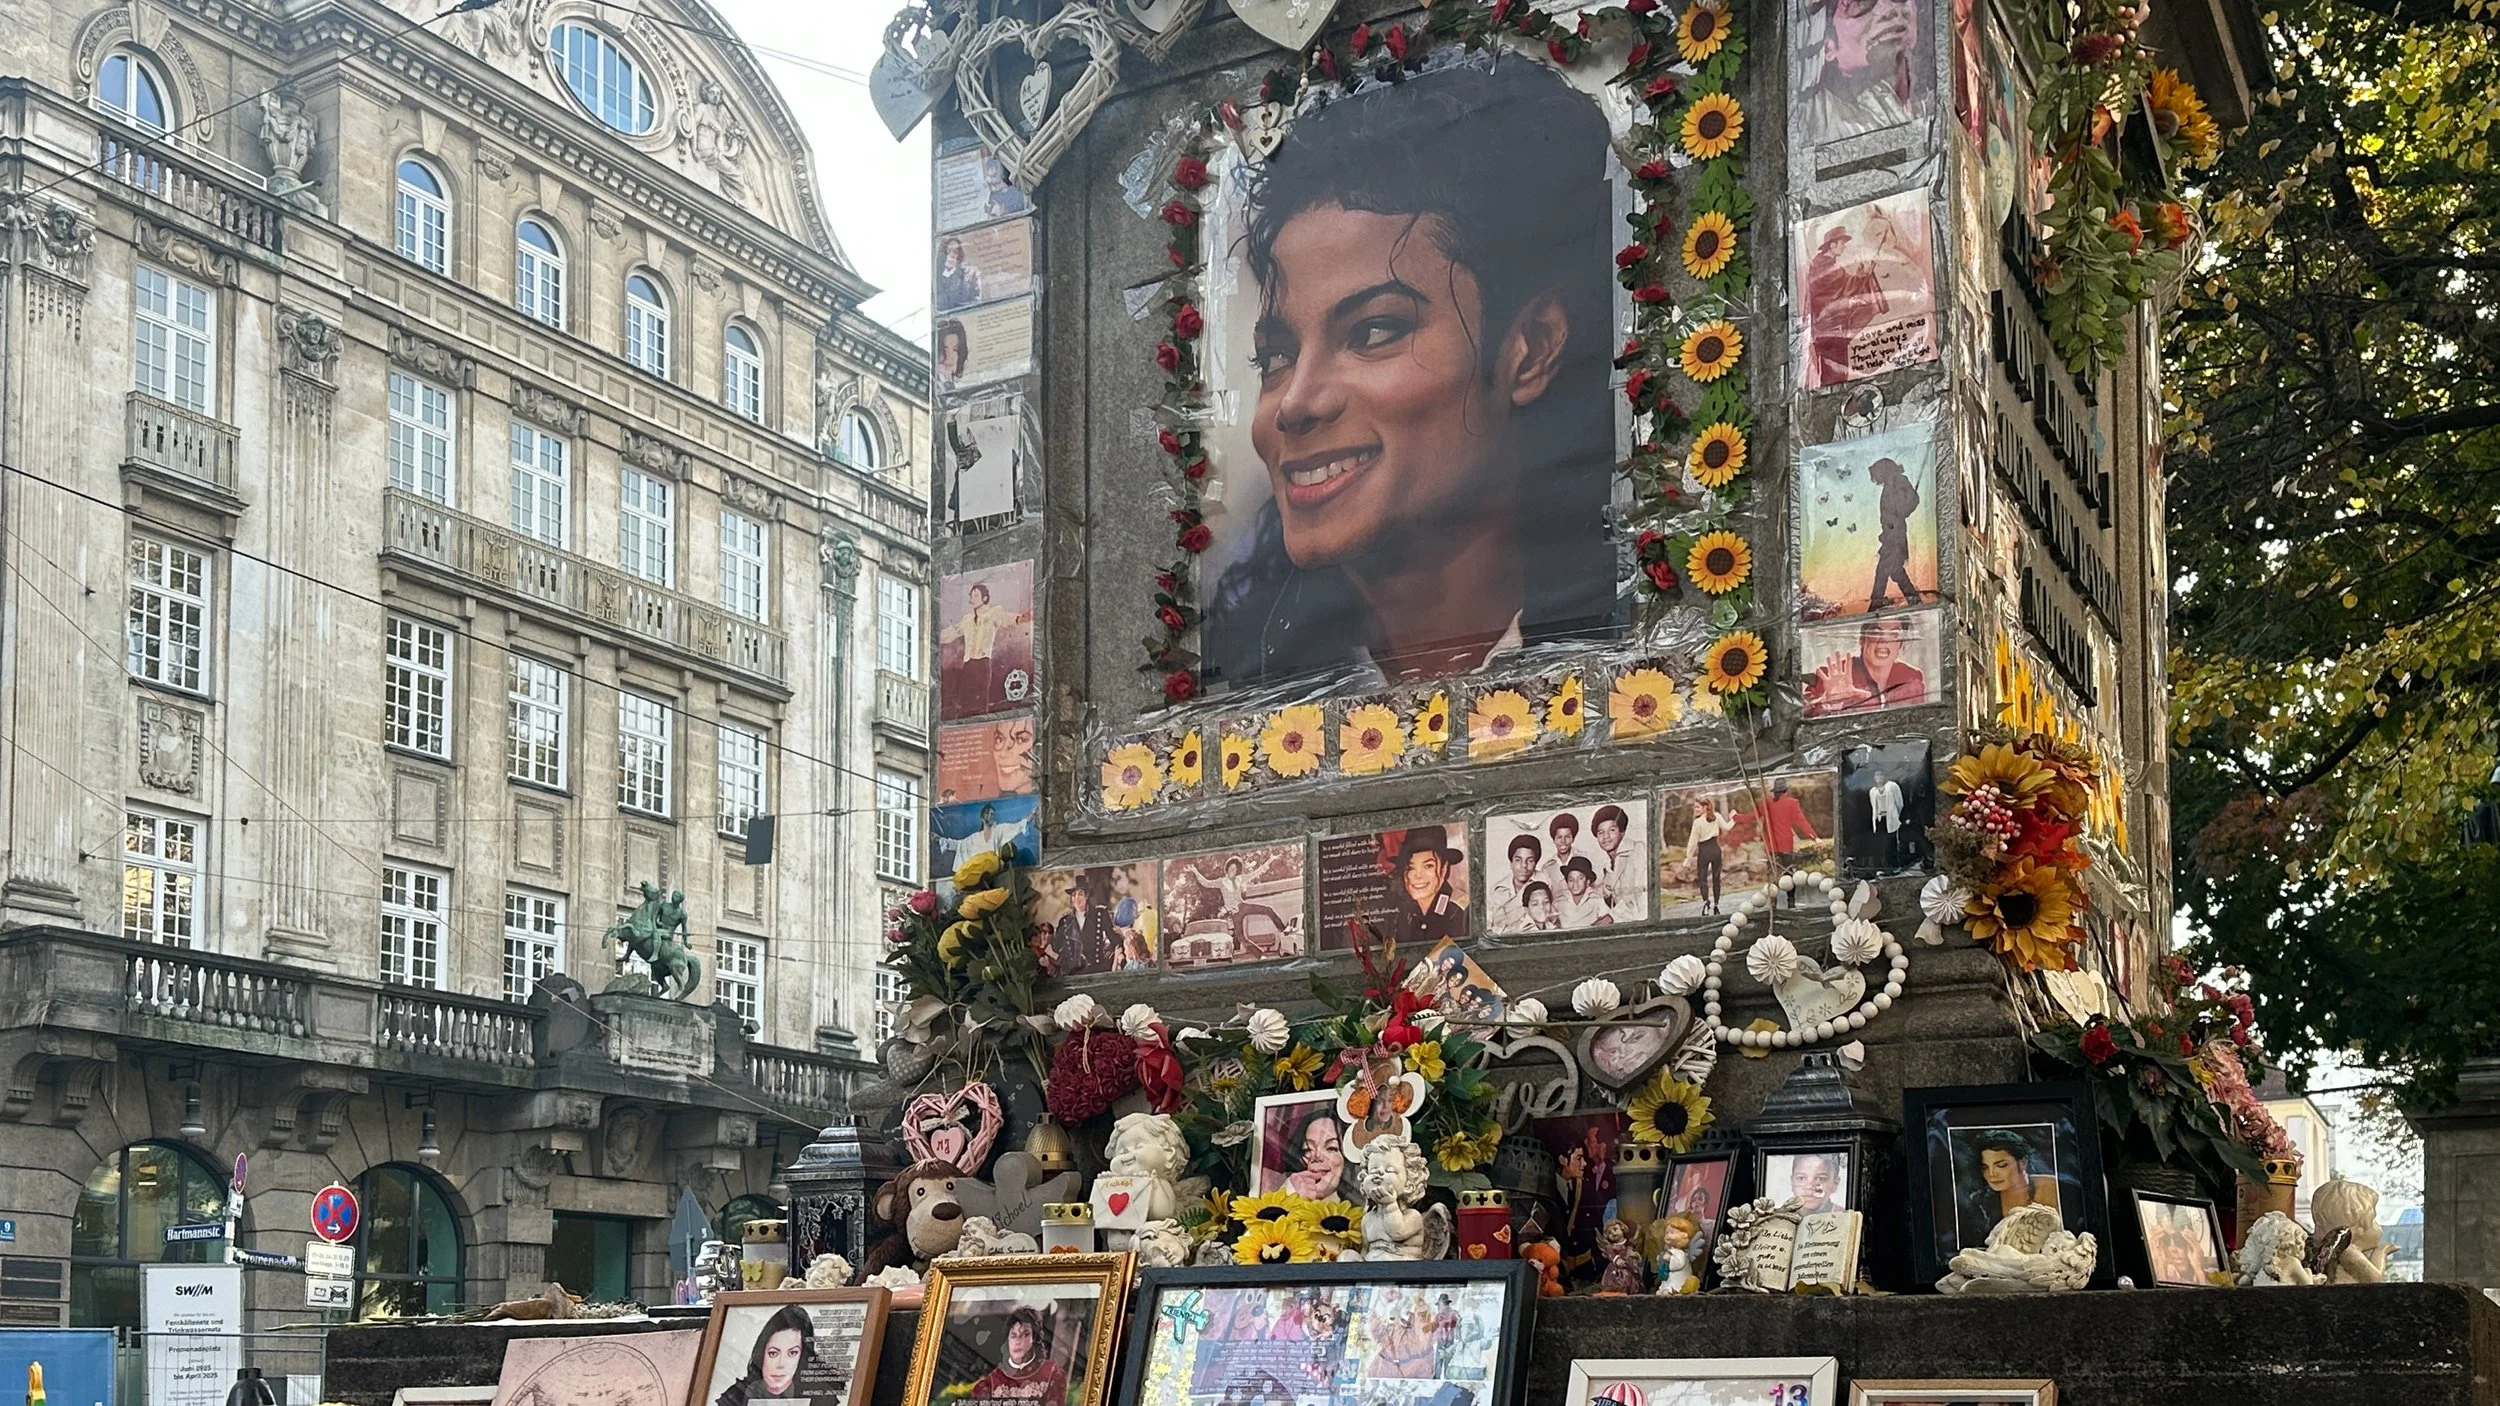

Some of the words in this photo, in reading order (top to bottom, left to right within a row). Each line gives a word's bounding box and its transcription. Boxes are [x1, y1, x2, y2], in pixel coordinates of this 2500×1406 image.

[1879, 347, 1896, 358] you
[1886, 321, 1903, 333] and
[1906, 318, 1926, 330] miss
[1994, 289, 2034, 402] VON
[2036, 364, 2099, 508] LUDWIG
[2076, 528, 2122, 642] BAYERN
[4, 1221, 11, 1232] 9
